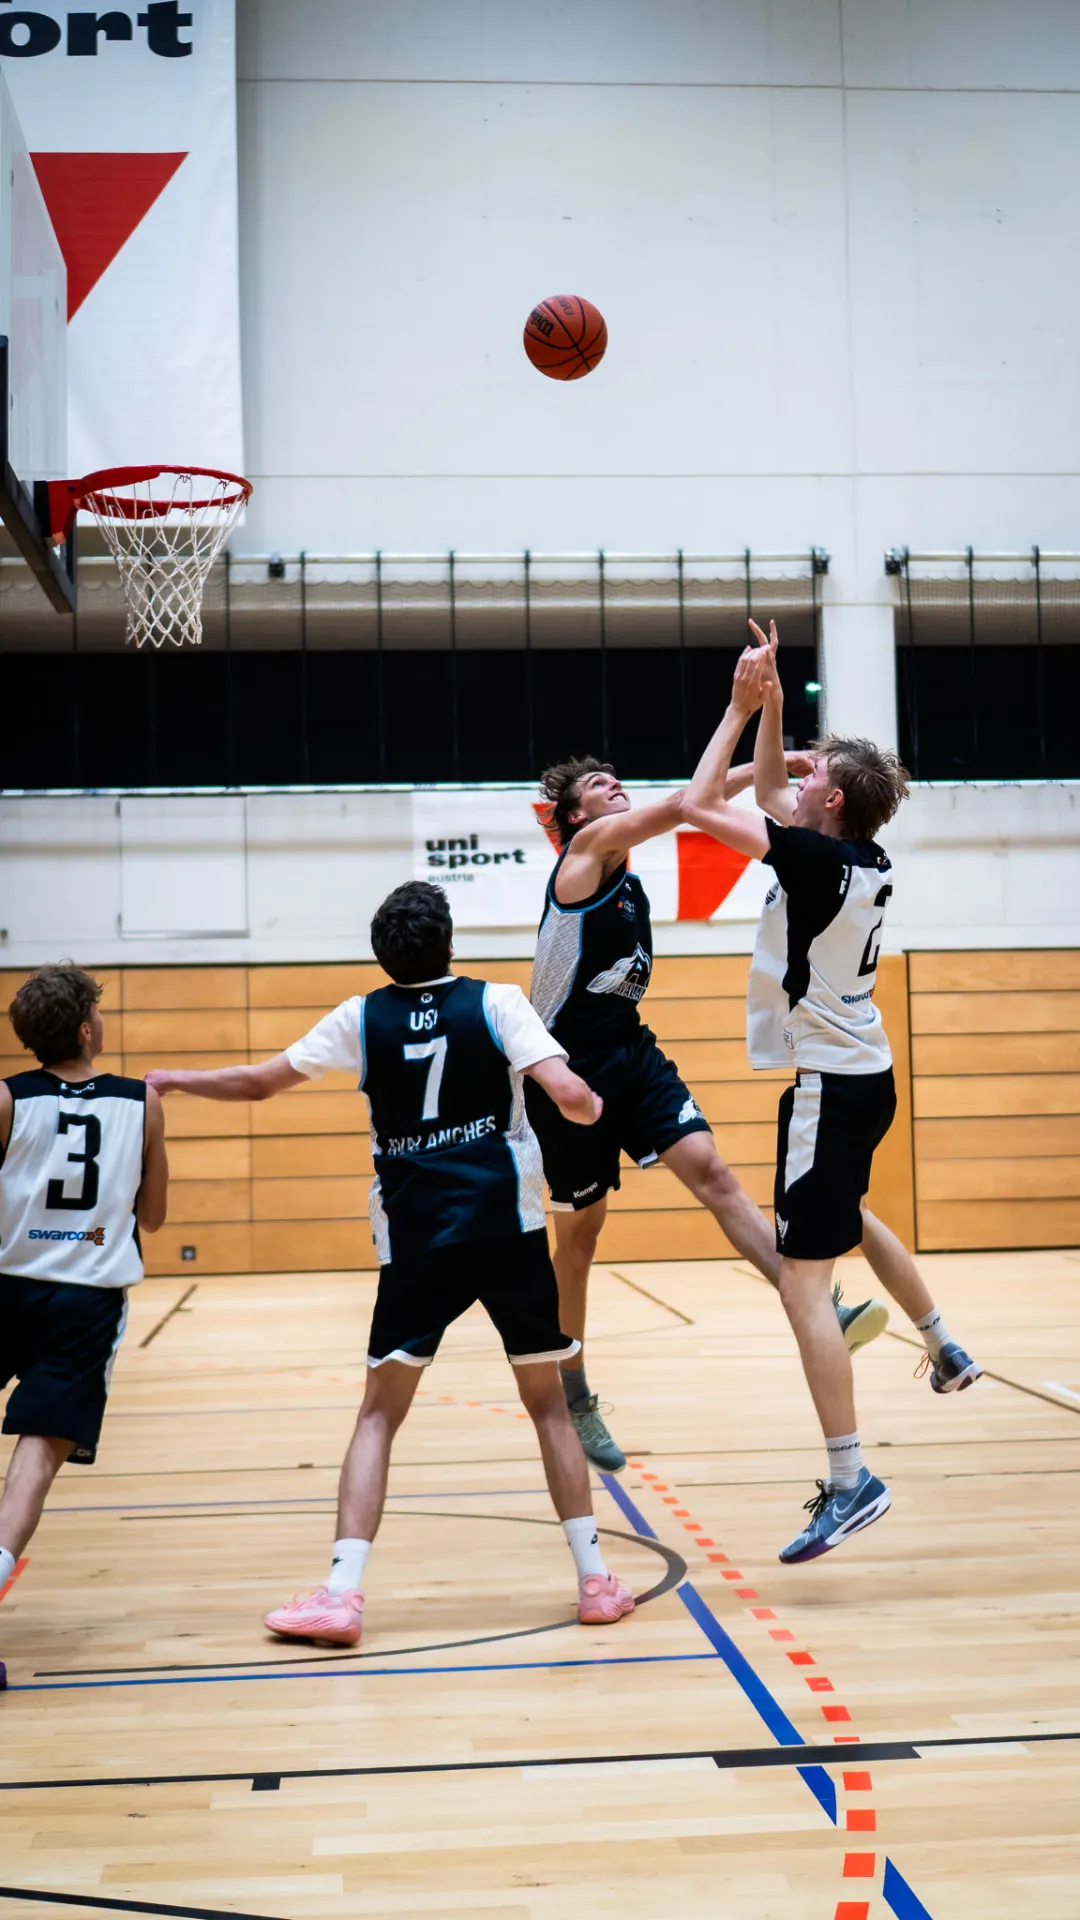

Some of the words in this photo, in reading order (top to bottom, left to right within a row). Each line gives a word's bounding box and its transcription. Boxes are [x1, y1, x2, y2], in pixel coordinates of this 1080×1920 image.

[426, 834, 479, 852] uni
[427, 848, 527, 869] sport
[857, 883, 893, 977] 2
[403, 1035, 448, 1121] 7
[45, 1111, 102, 1211] 3
[28, 1229, 86, 1241] swarco
